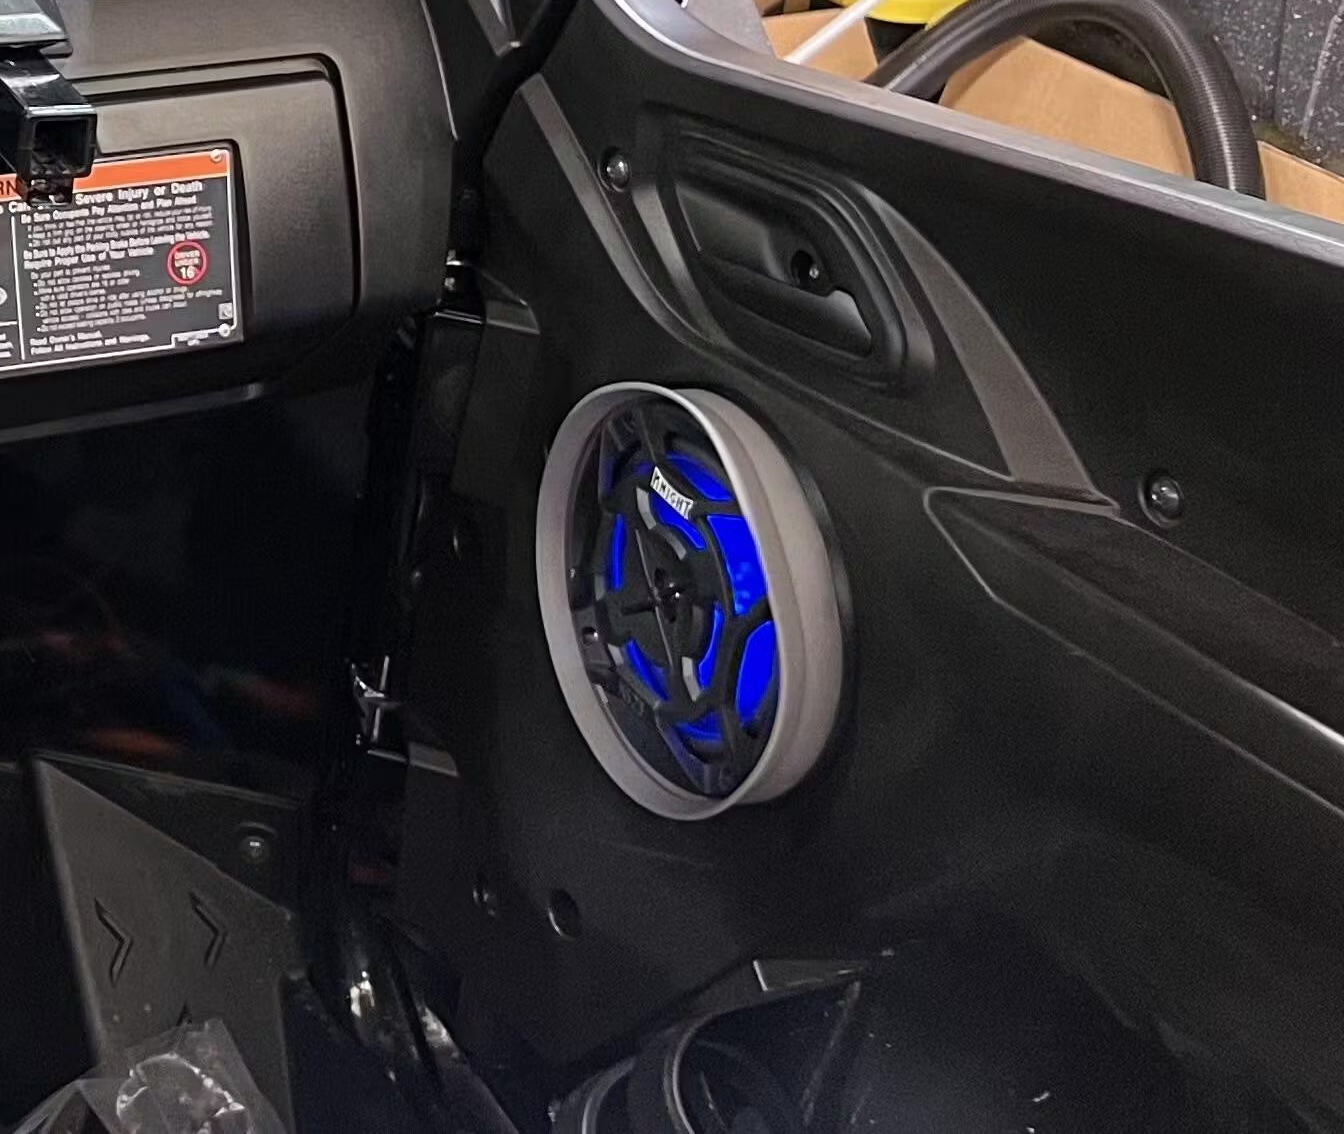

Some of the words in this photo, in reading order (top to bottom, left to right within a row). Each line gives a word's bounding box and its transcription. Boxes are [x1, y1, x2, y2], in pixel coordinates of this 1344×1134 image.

[76, 192, 112, 206] Severe
[118, 186, 149, 202] Injury
[154, 186, 166, 196] or
[171, 180, 203, 194] Death
